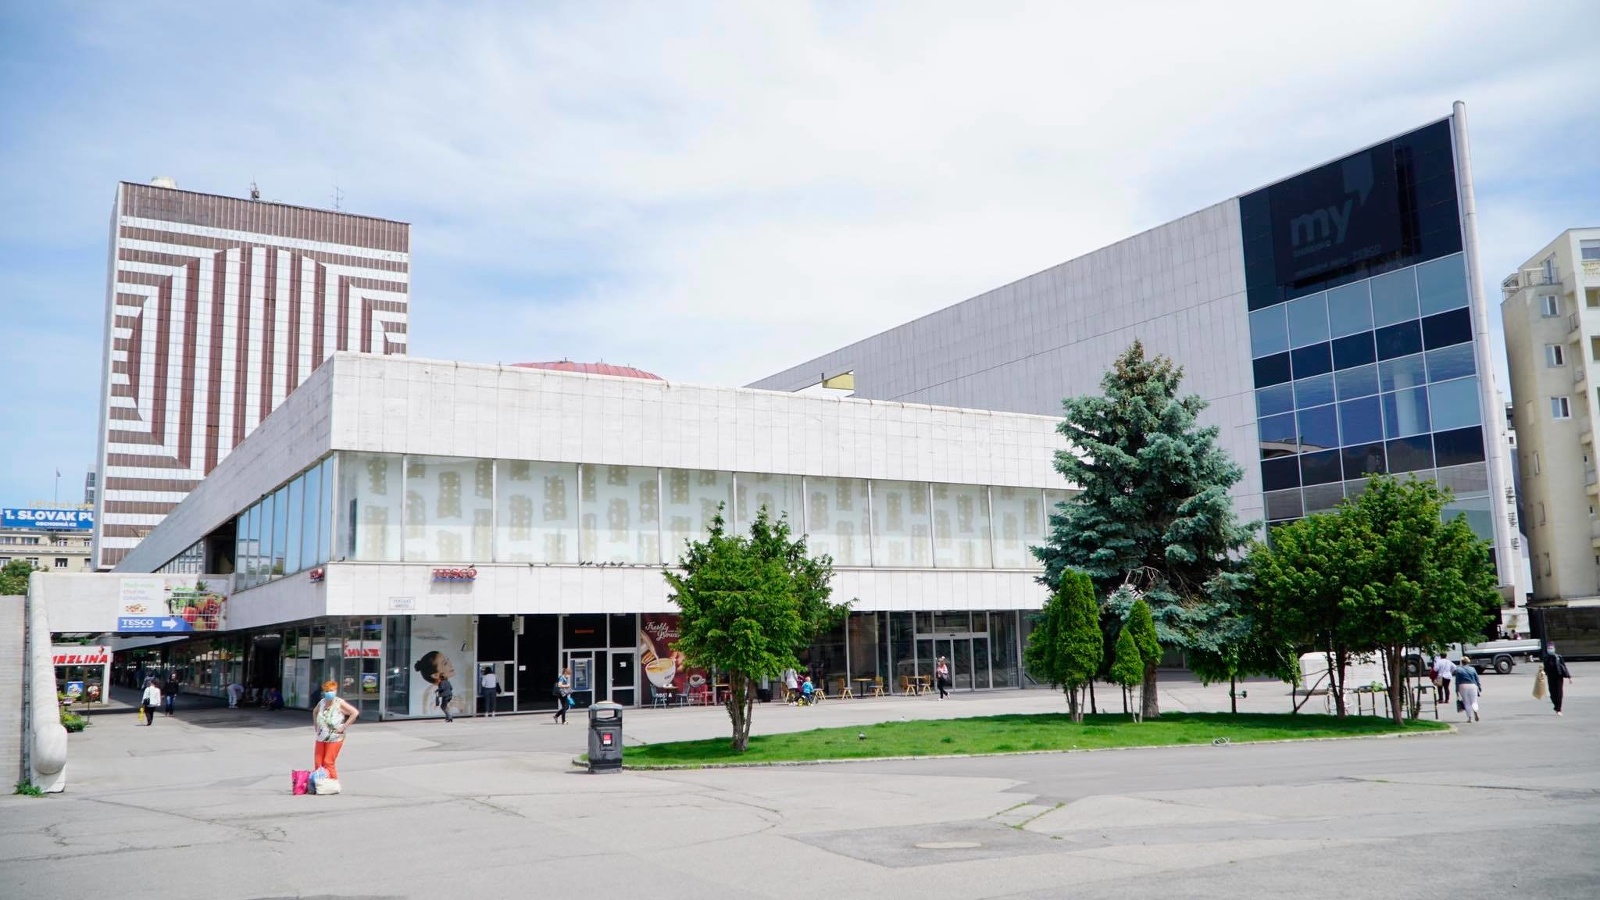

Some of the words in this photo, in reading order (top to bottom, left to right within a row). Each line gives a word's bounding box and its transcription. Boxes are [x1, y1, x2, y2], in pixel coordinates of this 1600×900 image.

[1291, 198, 1353, 247] my
[5, 510, 15, 520] 1.
[18, 510, 76, 521] SLOVAK
[432, 568, 477, 578] TESCO
